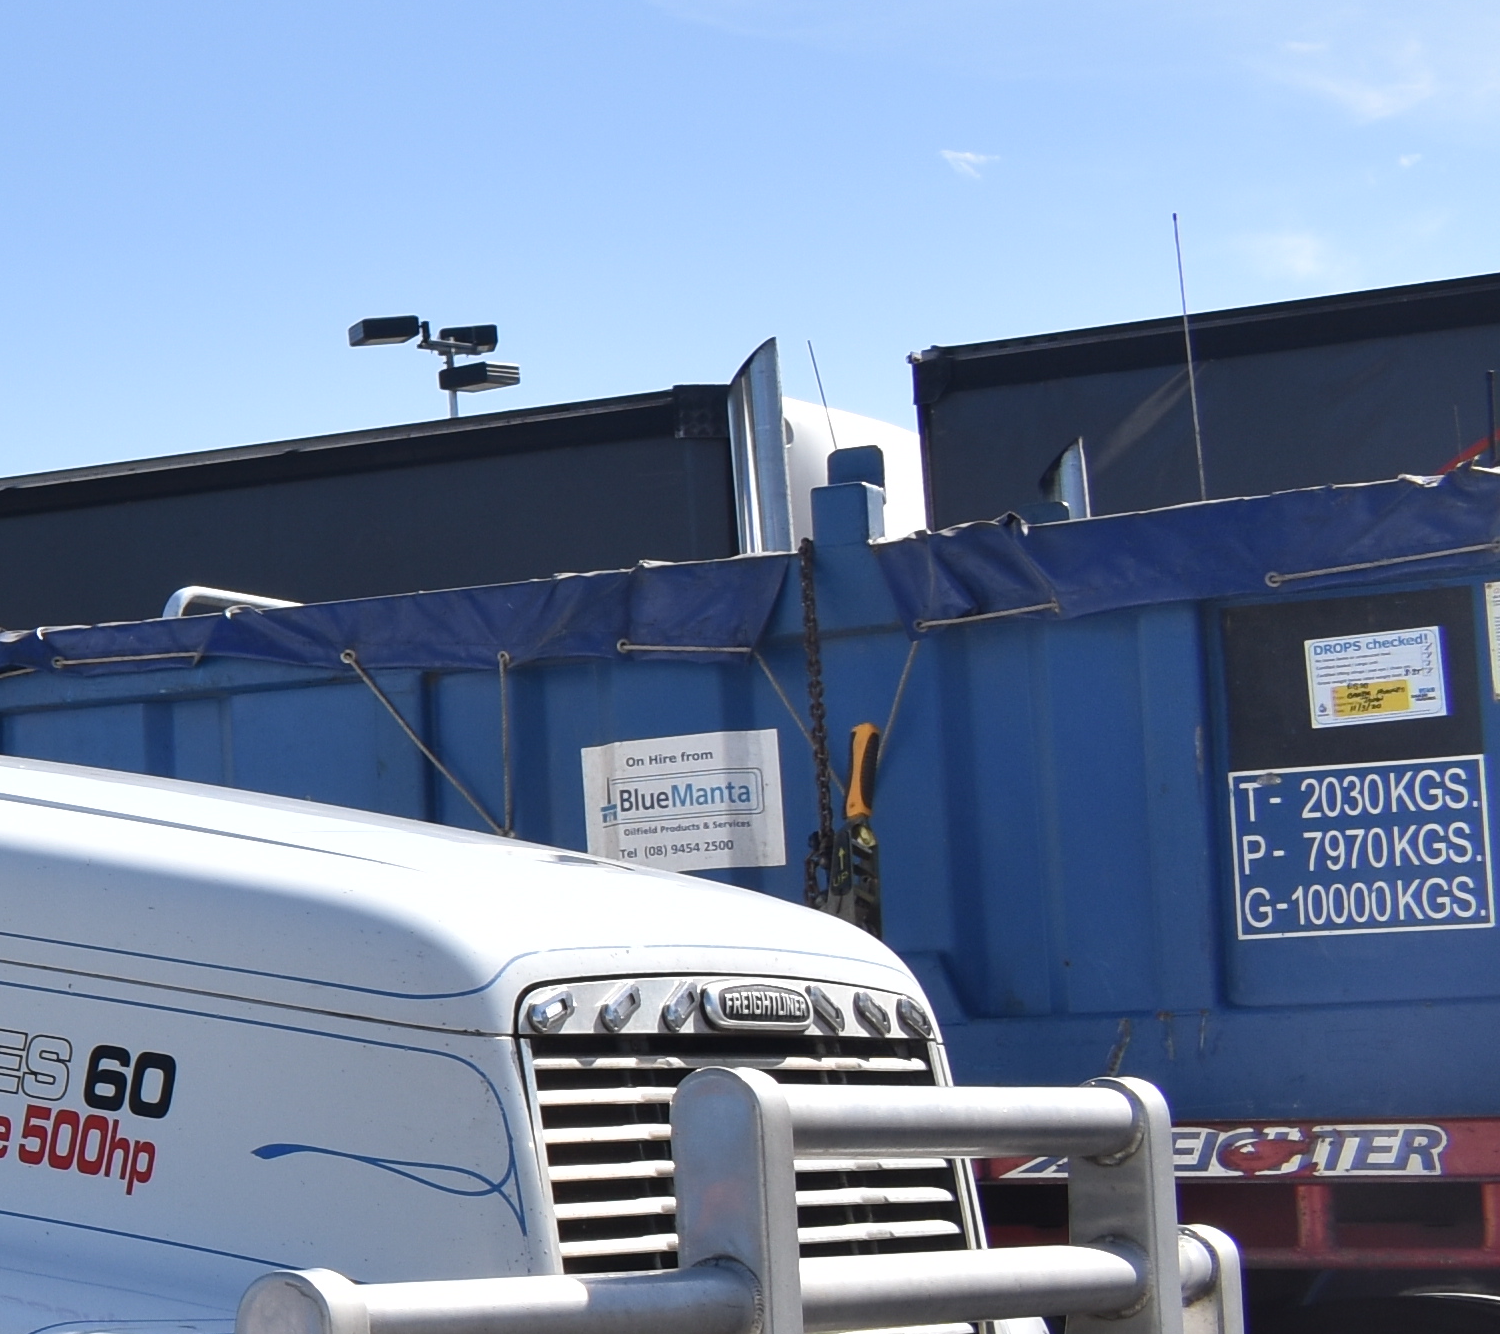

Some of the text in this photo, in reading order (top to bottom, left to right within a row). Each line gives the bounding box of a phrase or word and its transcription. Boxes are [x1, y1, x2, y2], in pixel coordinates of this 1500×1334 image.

[1313, 633, 1428, 656] DROPS checked!
[625, 750, 714, 767] On Hire from
[619, 782, 752, 813] BlueManta
[1301, 773, 1383, 818] 2030
[623, 820, 751, 837] Oilfield Products & Services
[620, 840, 734, 859] Tel (08) 9454 2500
[1303, 827, 1387, 871] 7970
[724, 991, 808, 1017] FREIGHTLINER
[83, 1044, 177, 1119] 60
[18, 1103, 156, 1196] 500hp
